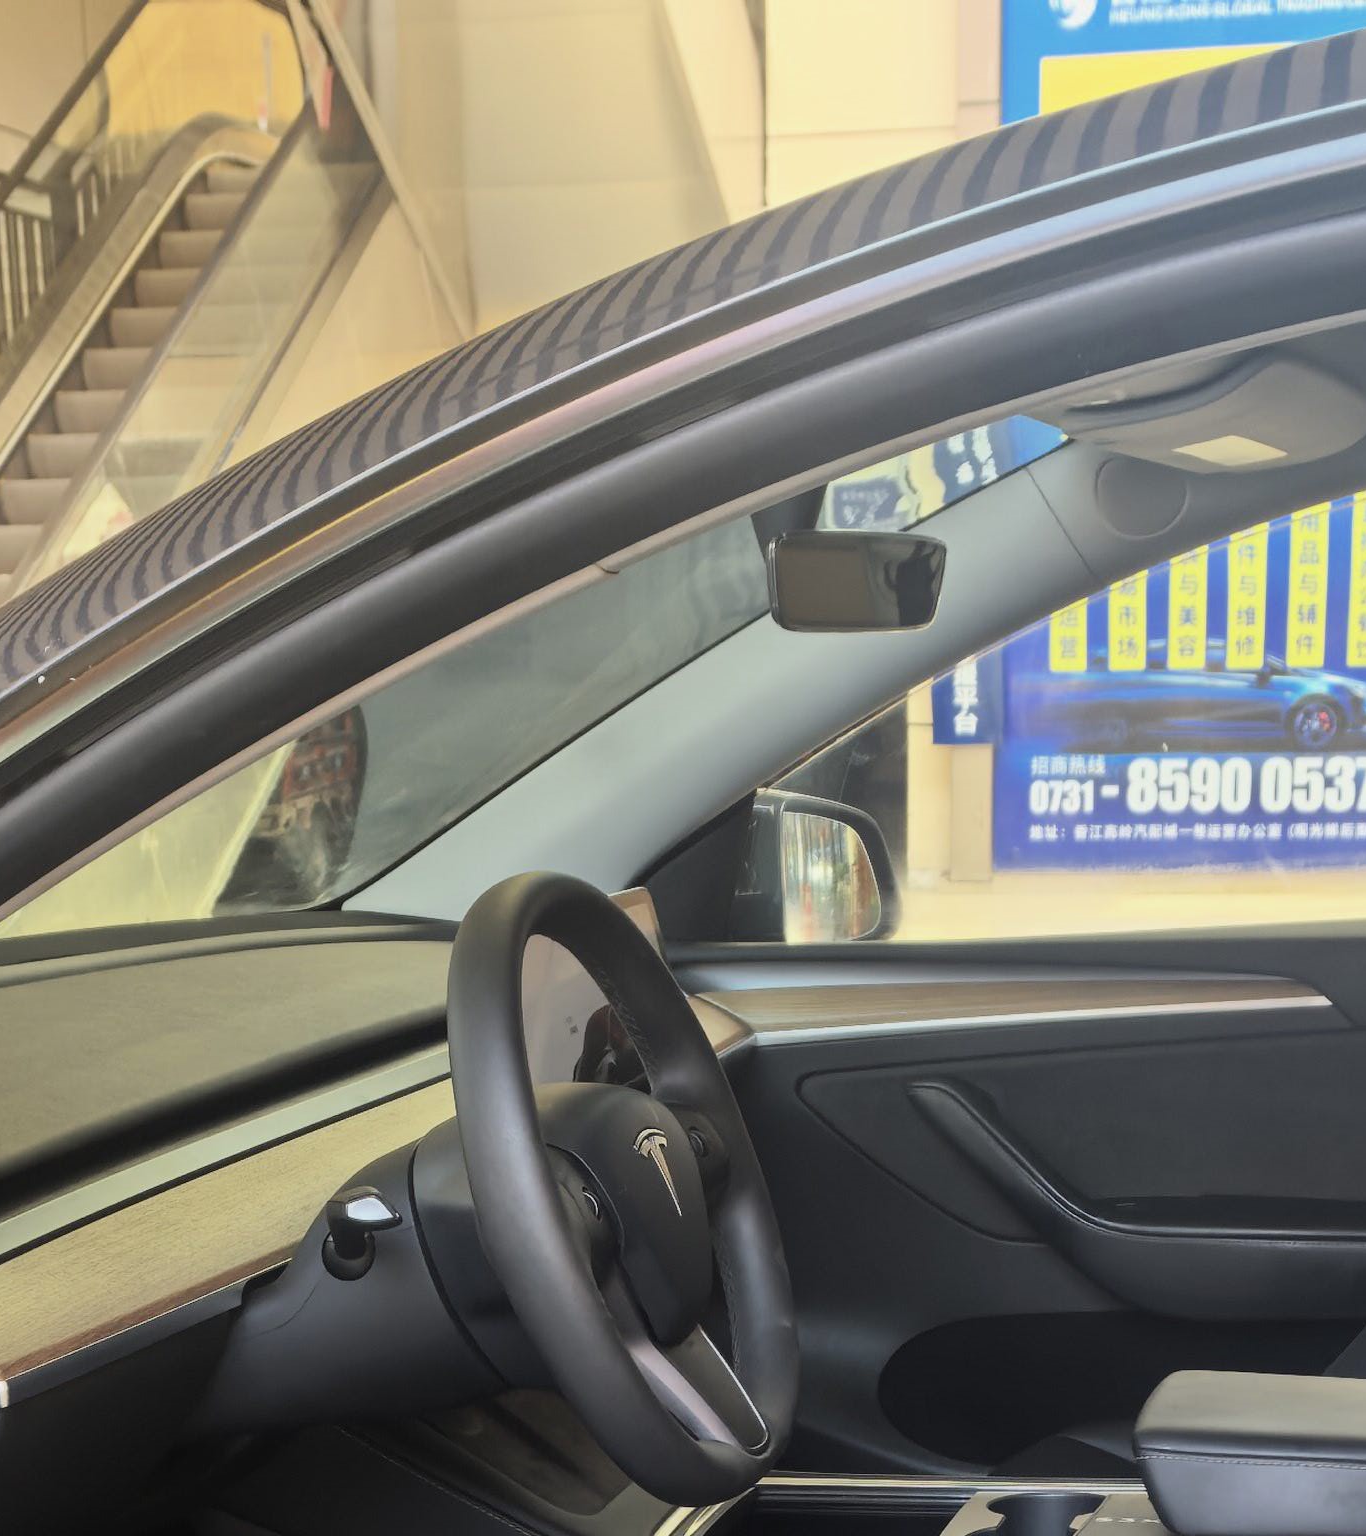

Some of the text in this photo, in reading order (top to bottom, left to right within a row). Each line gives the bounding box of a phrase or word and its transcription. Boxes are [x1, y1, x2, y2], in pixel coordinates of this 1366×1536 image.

[1031, 754, 1106, 775] 招商热线
[1029, 779, 1094, 815] 0731
[1127, 757, 1252, 815] 8590
